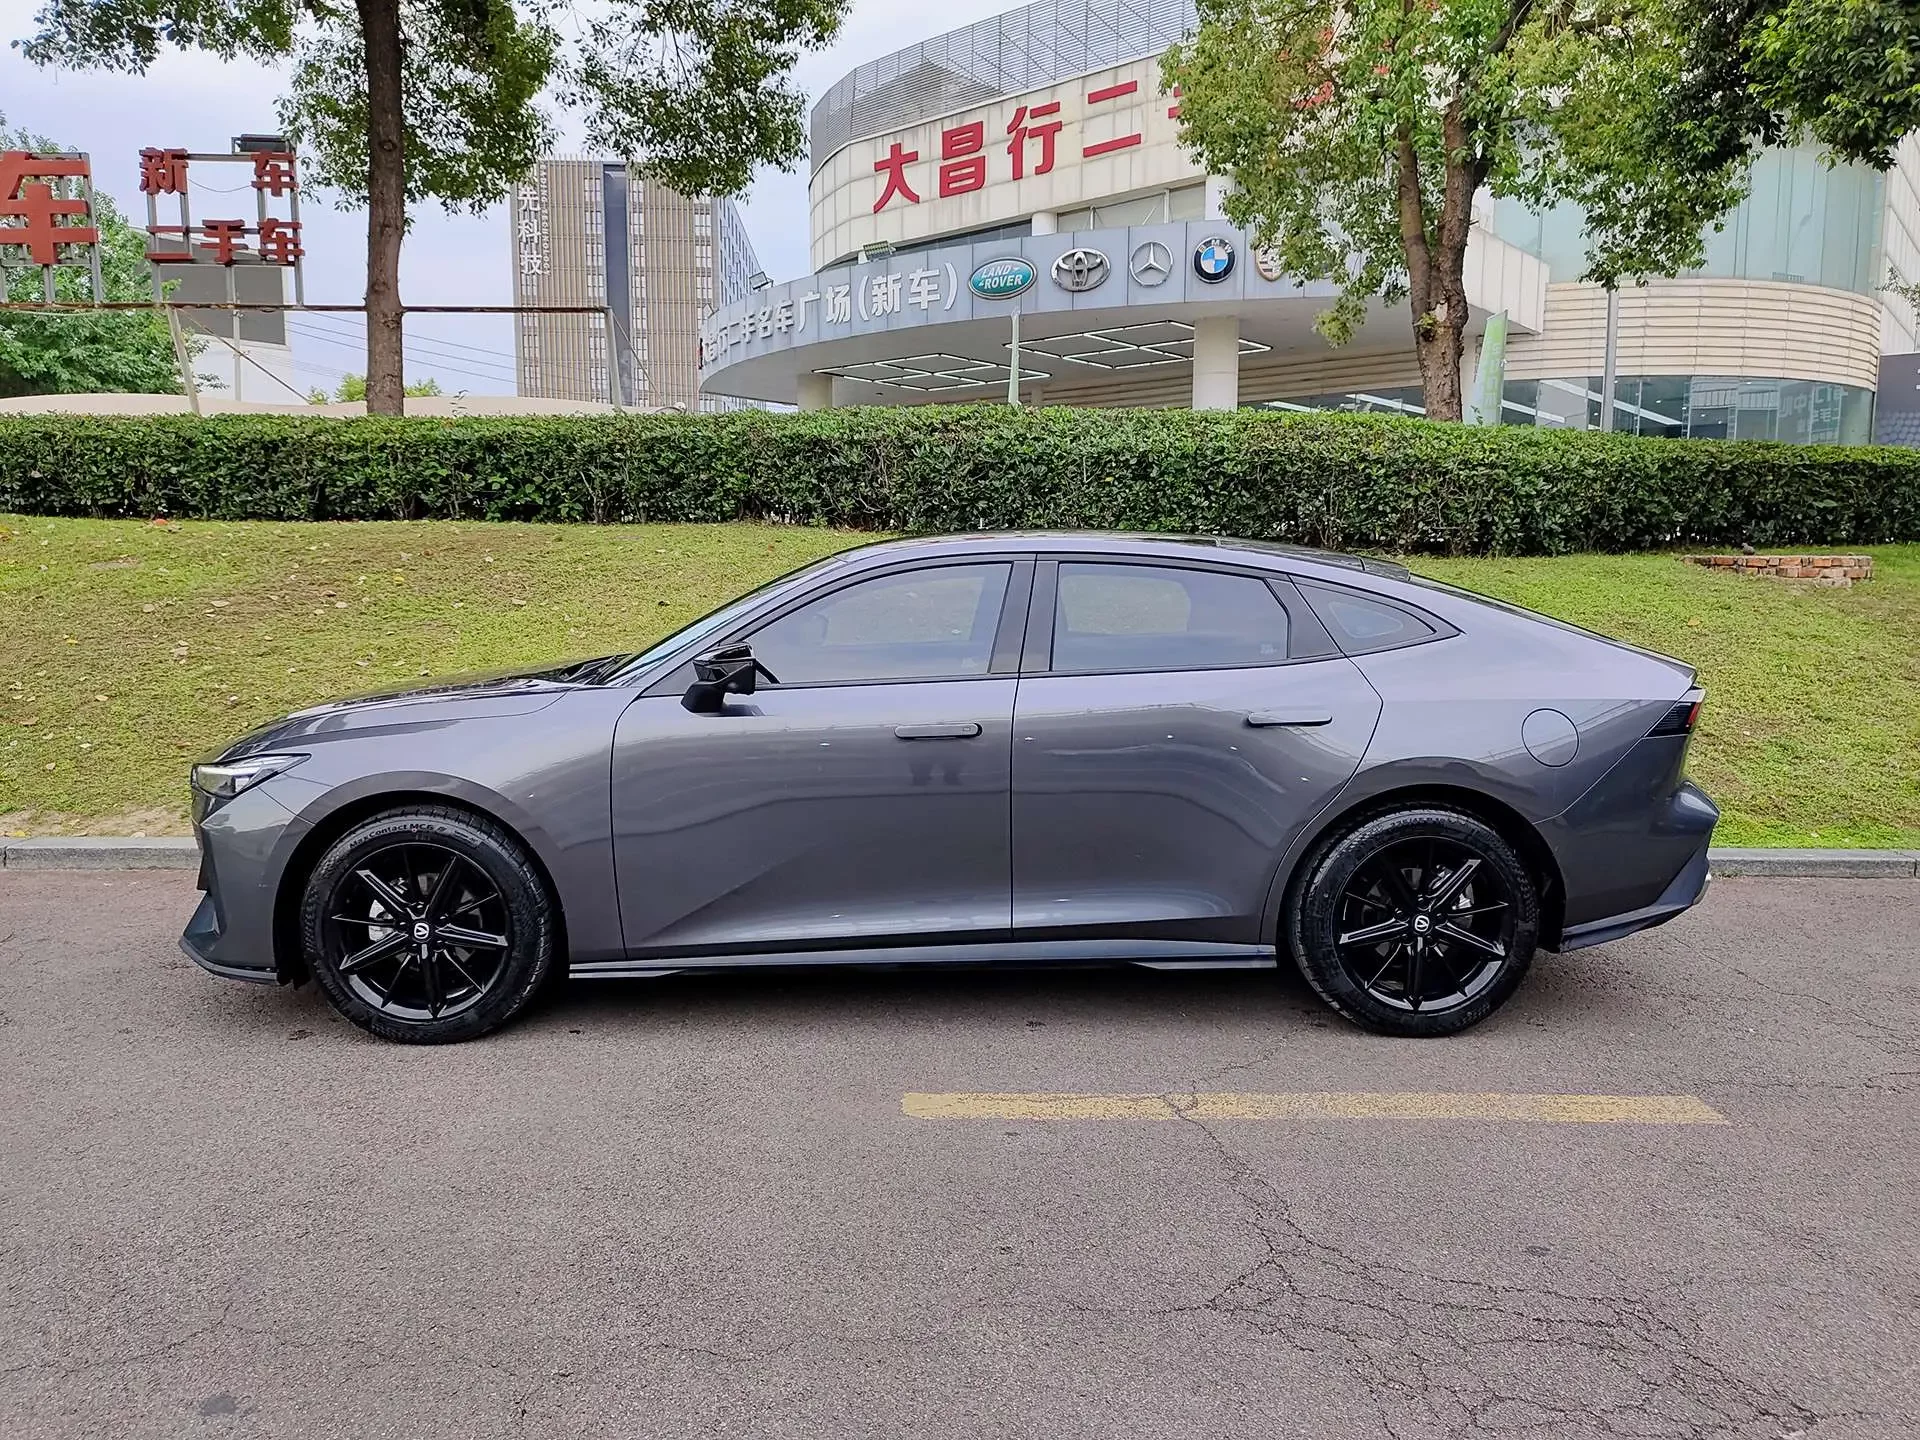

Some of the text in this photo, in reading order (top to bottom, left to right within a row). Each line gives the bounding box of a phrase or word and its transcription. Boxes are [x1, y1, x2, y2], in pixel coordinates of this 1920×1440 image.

[873, 80, 1183, 214] 大昌行二
[139, 147, 299, 197] 新车
[0, 150, 98, 264] 车
[518, 165, 542, 274] 先科技
[145, 218, 305, 264] 二手车
[981, 264, 1012, 279] LAND
[983, 274, 1023, 290] ROVER
[349, 825, 407, 849] MaxContact
